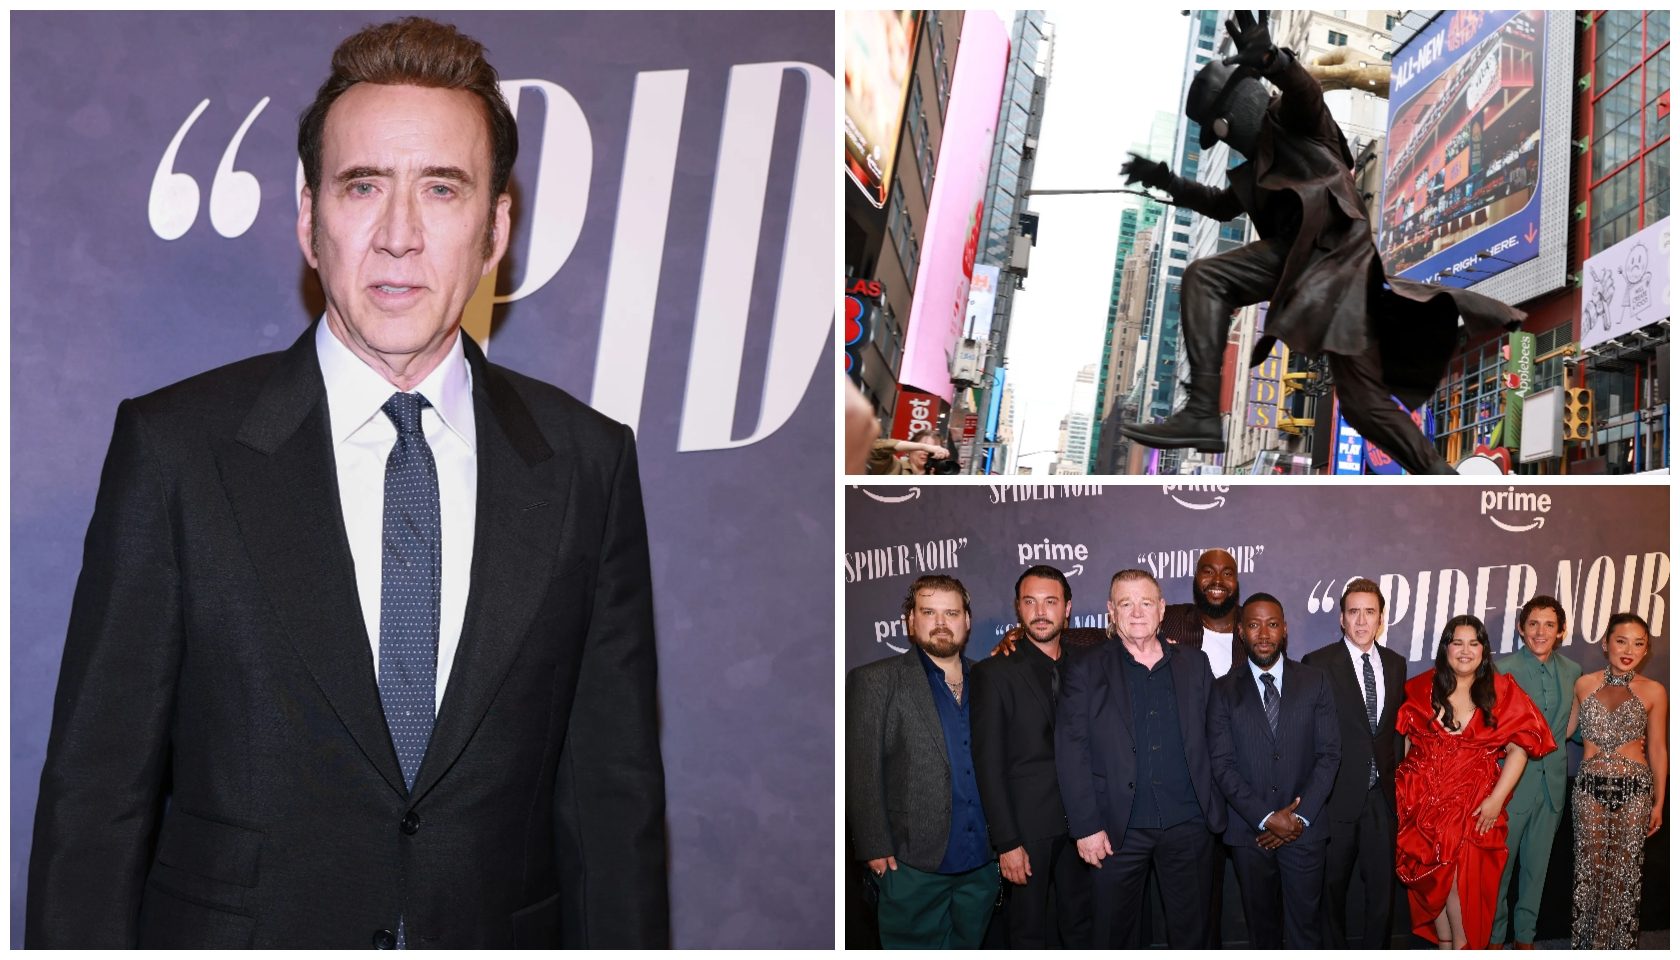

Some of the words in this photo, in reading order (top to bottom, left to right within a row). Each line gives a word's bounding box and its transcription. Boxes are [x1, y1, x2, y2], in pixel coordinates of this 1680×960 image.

[1395, 29, 1446, 92] ALL-NEW
[148, 61, 835, 453] “PID
[1452, 253, 1482, 275] RIGH
[1255, 344, 1278, 427] UDS
[1515, 336, 1531, 398] Applebee's
[1480, 486, 1552, 515] prime
[1018, 538, 1088, 564] prime
[874, 615, 909, 642] pri
[1308, 551, 1670, 662] “PIDERNOIR
